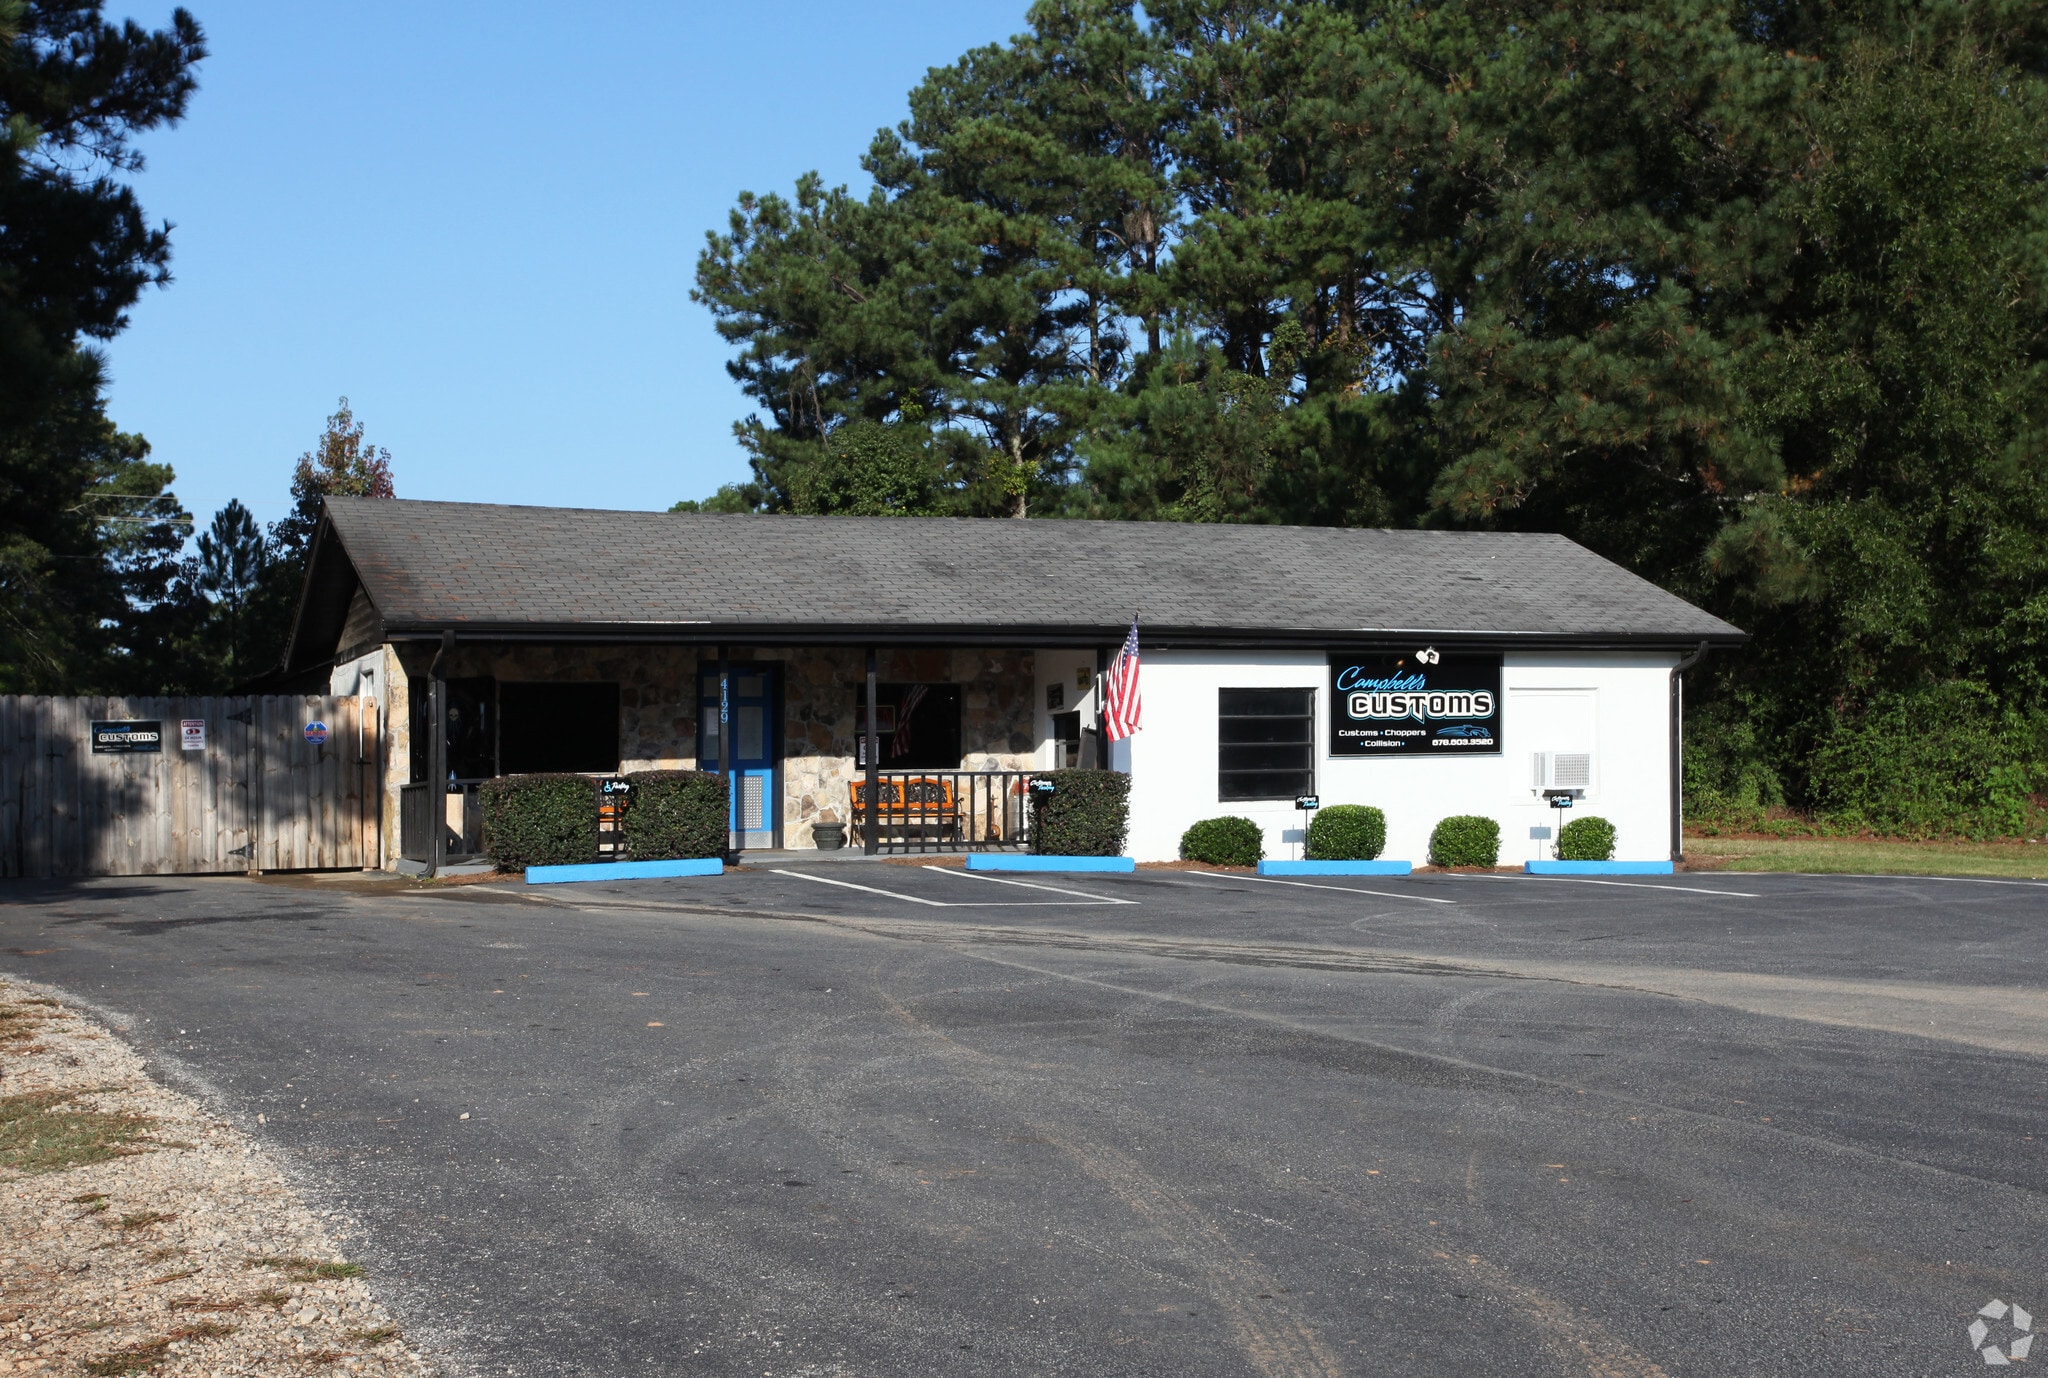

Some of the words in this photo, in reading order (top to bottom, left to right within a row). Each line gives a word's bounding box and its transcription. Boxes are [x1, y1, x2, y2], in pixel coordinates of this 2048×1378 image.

[1337, 666, 1427, 697] Campbell's
[720, 678, 729, 724] 4129
[1350, 691, 1492, 721] CUSTOMS
[99, 732, 159, 743] CUSTOMS
[1338, 729, 1379, 737] Customs
[1384, 728, 1427, 737] Choppers
[1364, 739, 1401, 748] Collision
